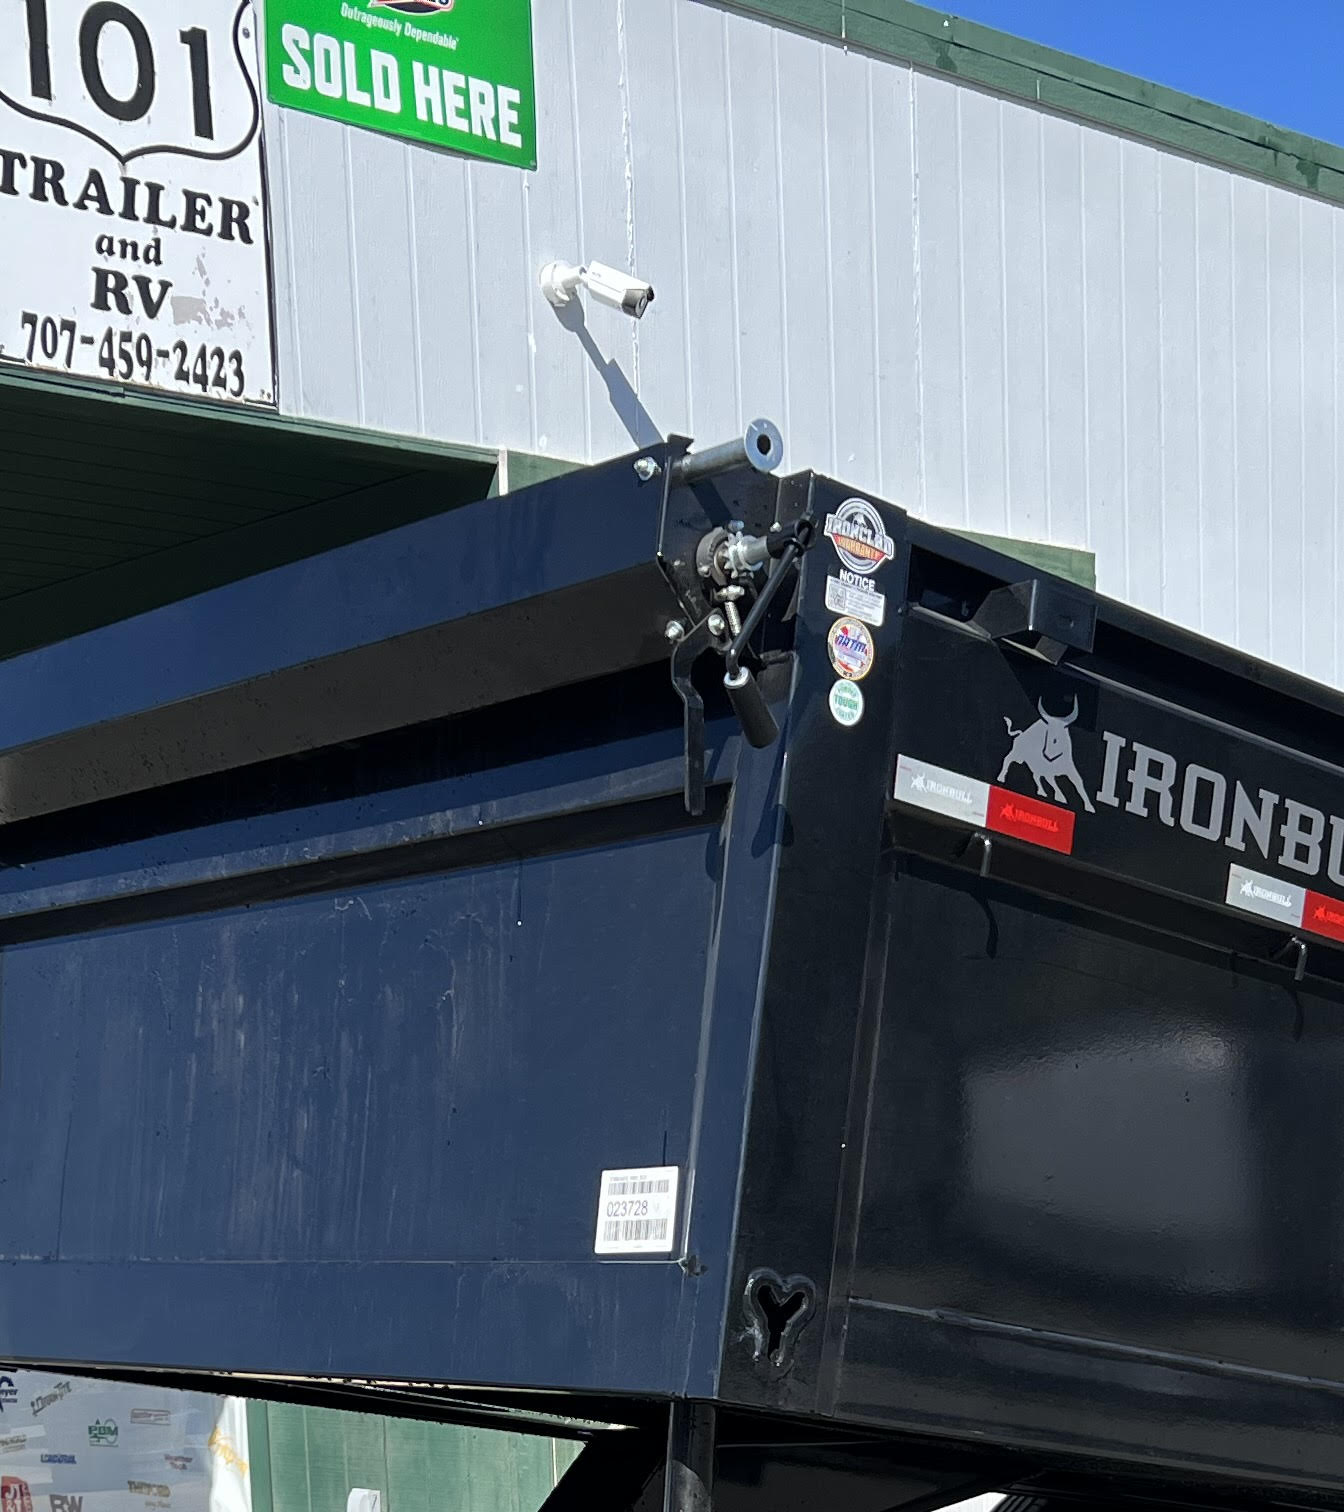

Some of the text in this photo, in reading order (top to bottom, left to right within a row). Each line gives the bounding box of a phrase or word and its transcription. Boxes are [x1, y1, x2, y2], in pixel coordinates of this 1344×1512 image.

[340, 2, 402, 36] Outrageously
[25, 0, 214, 141] 101
[281, 25, 523, 149] SOLD HERE
[95, 233, 163, 266] and
[90, 266, 173, 319] RV
[21, 311, 246, 398] 707-459-2423
[827, 516, 893, 557] IRONCLAD
[839, 568, 876, 592] NOTICE
[926, 779, 973, 804] IRONBULL
[1015, 809, 1059, 833] IRONBULL
[607, 1200, 649, 1217] 023728
